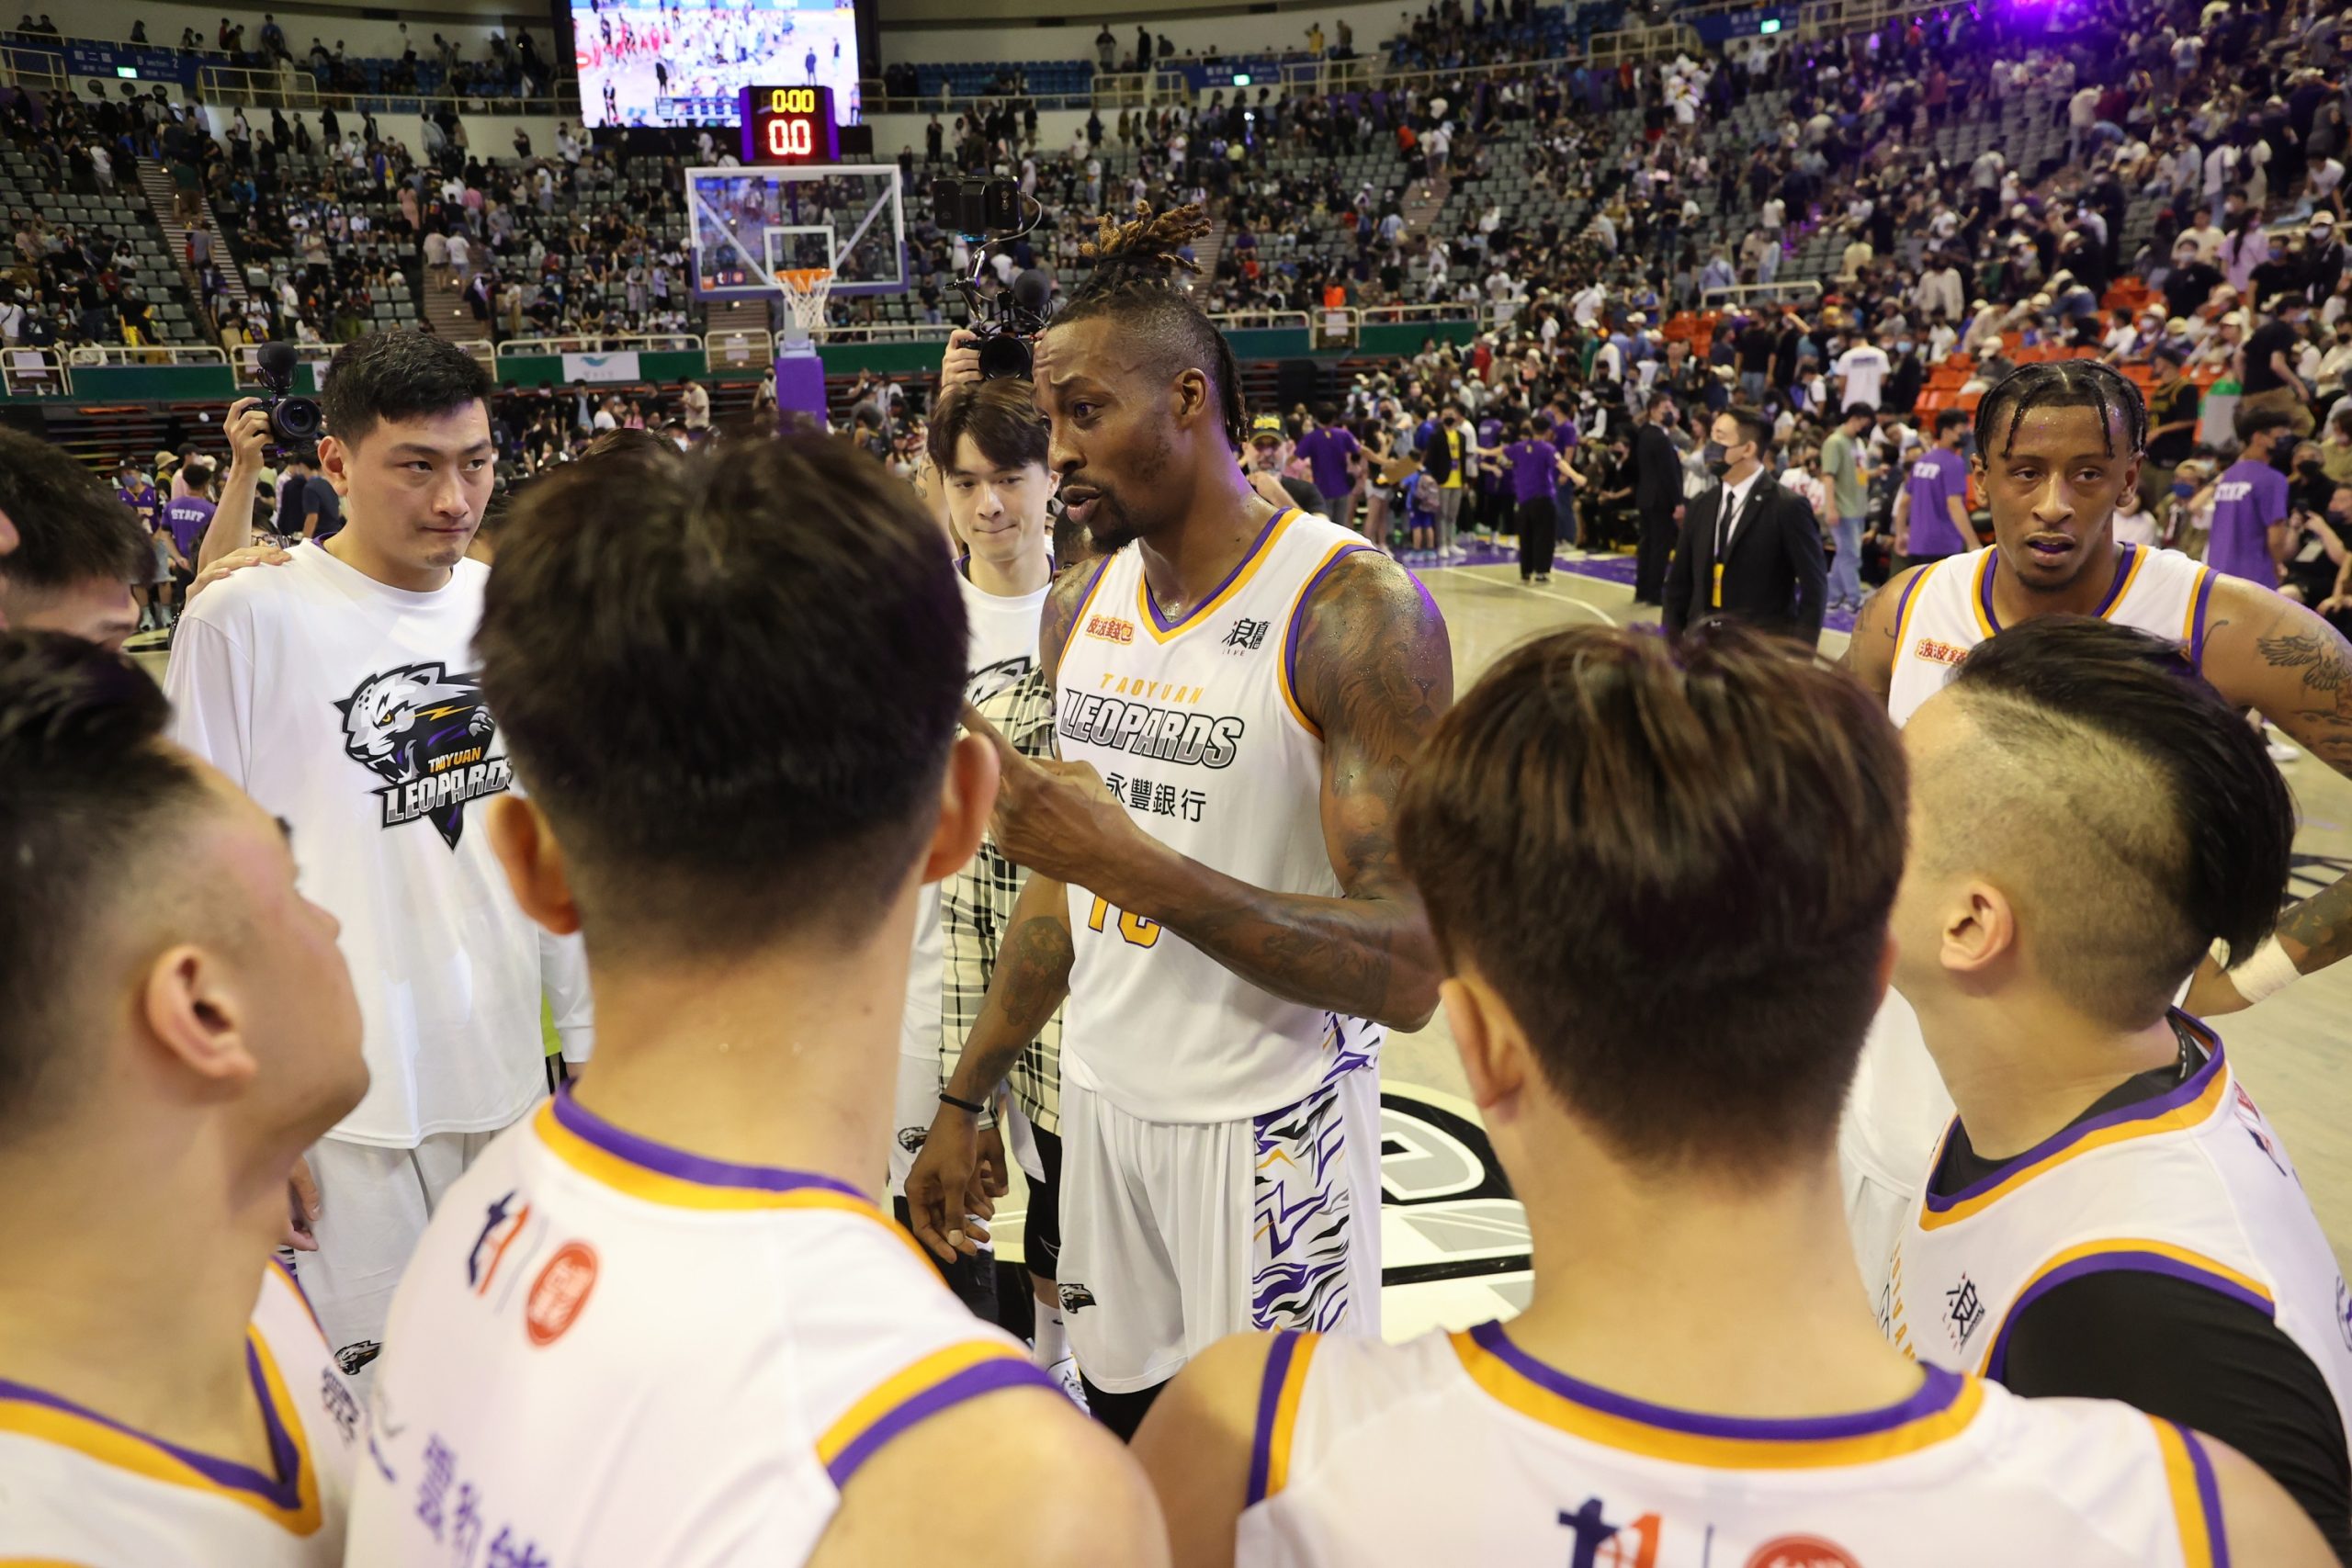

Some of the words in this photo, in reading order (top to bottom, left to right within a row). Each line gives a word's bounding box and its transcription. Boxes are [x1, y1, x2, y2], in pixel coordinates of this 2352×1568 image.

[170, 508, 206, 523] STAFF
[1101, 672, 1204, 705] TAOYUAN
[1059, 687, 1245, 770] LEOPARDS
[1105, 772, 1206, 823] 永豐銀行
